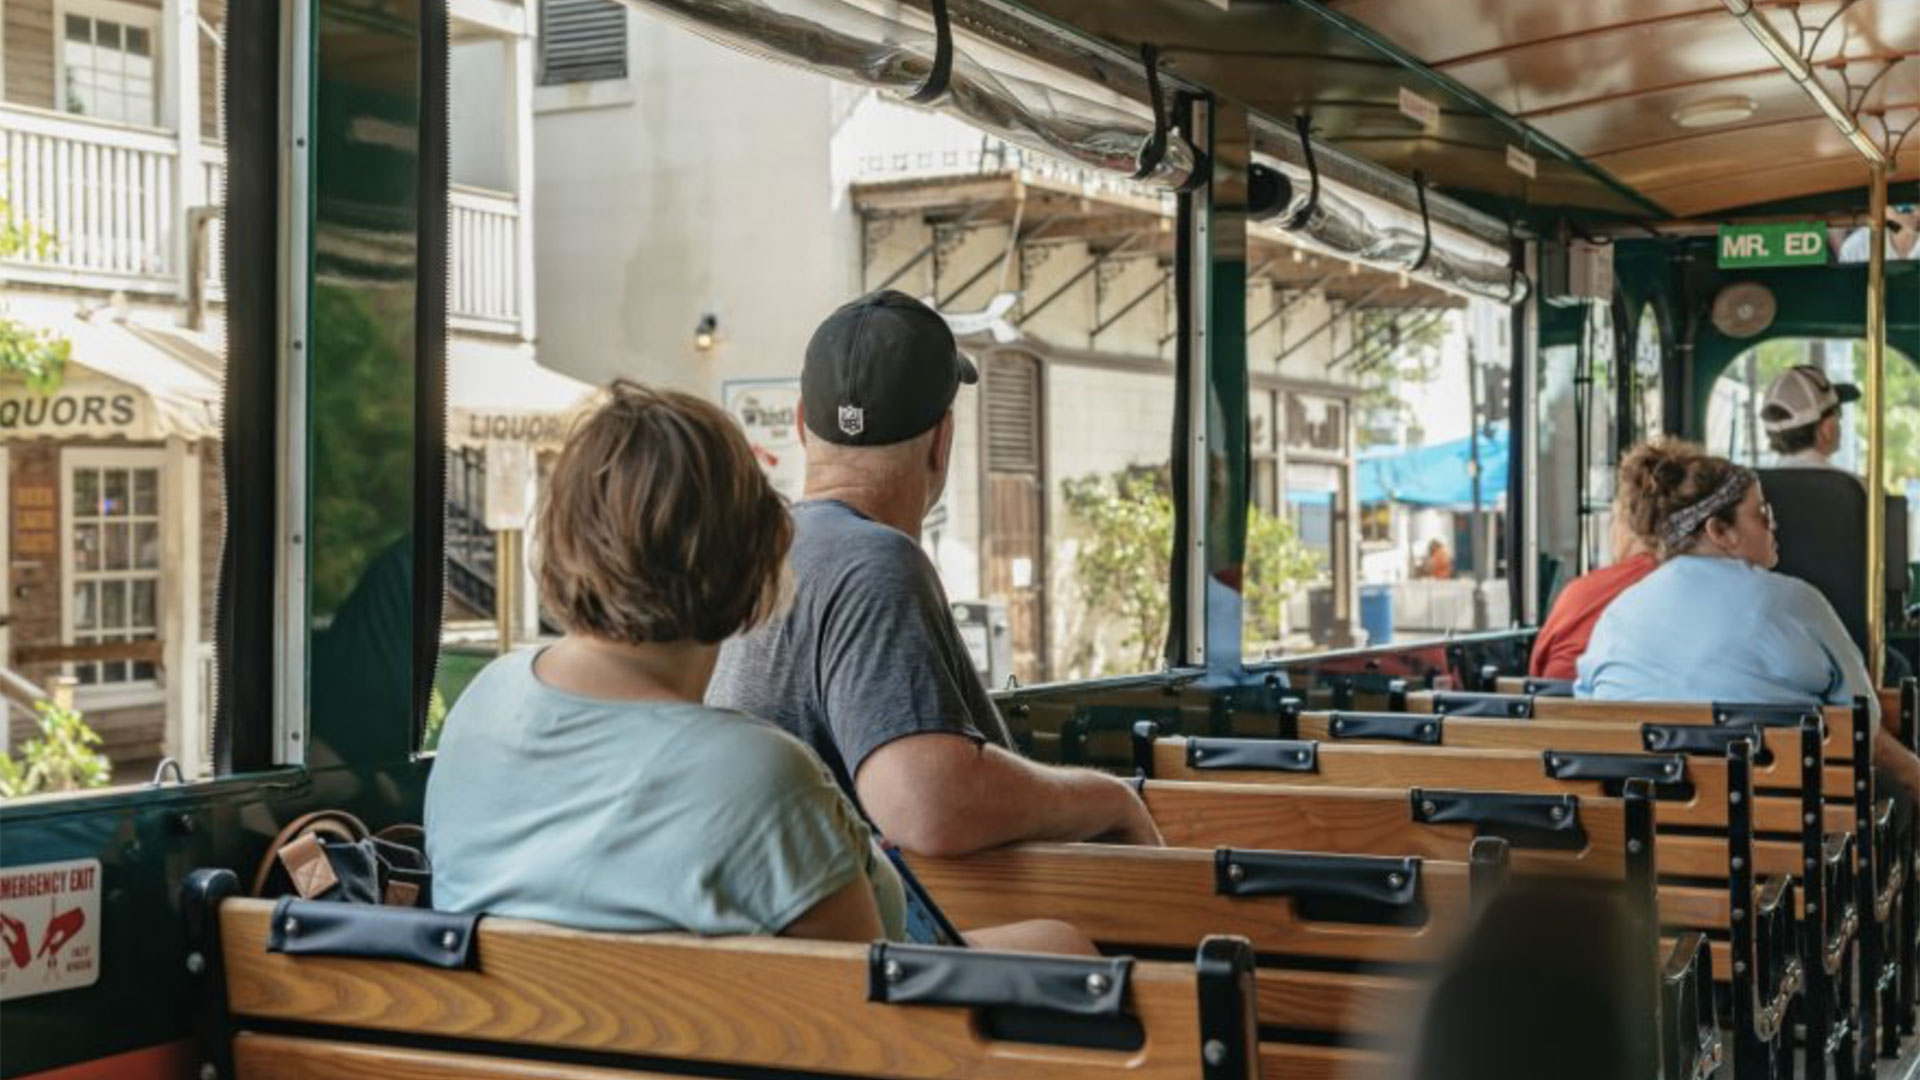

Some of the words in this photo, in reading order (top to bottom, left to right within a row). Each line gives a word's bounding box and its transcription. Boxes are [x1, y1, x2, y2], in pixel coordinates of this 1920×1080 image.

[1722, 233, 1769, 257] MR.
[1784, 232, 1822, 255] ED
[70, 867, 95, 892] EXIT
